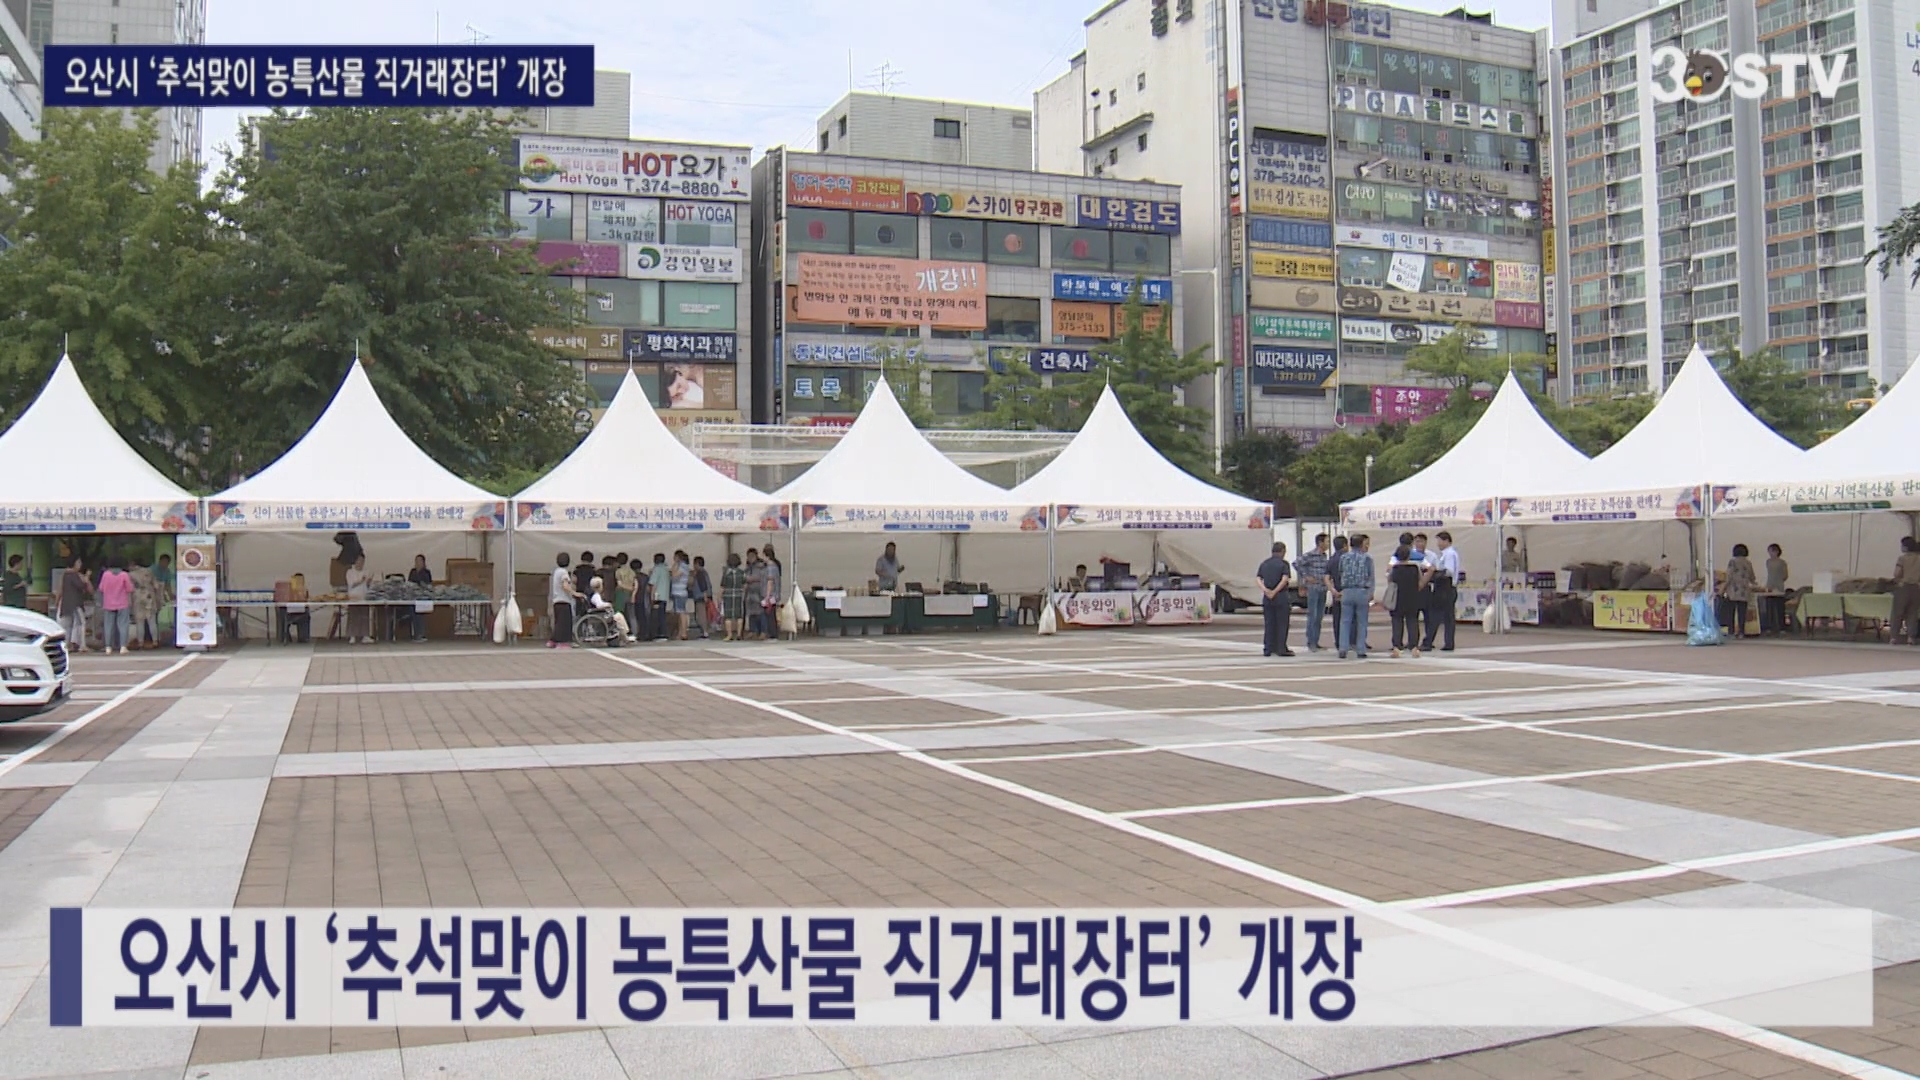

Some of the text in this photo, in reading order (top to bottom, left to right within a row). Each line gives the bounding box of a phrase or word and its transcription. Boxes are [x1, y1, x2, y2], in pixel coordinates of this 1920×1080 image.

[559, 171, 582, 185] Hot
[591, 199, 627, 212] 한달에
[666, 204, 733, 224] HOT YOGA
[1080, 196, 1178, 226] 대한검도
[663, 255, 734, 273] 경인일보
[915, 266, 978, 294] 개강!!
[600, 332, 619, 349] 3F
[645, 332, 713, 353] 평화치과
